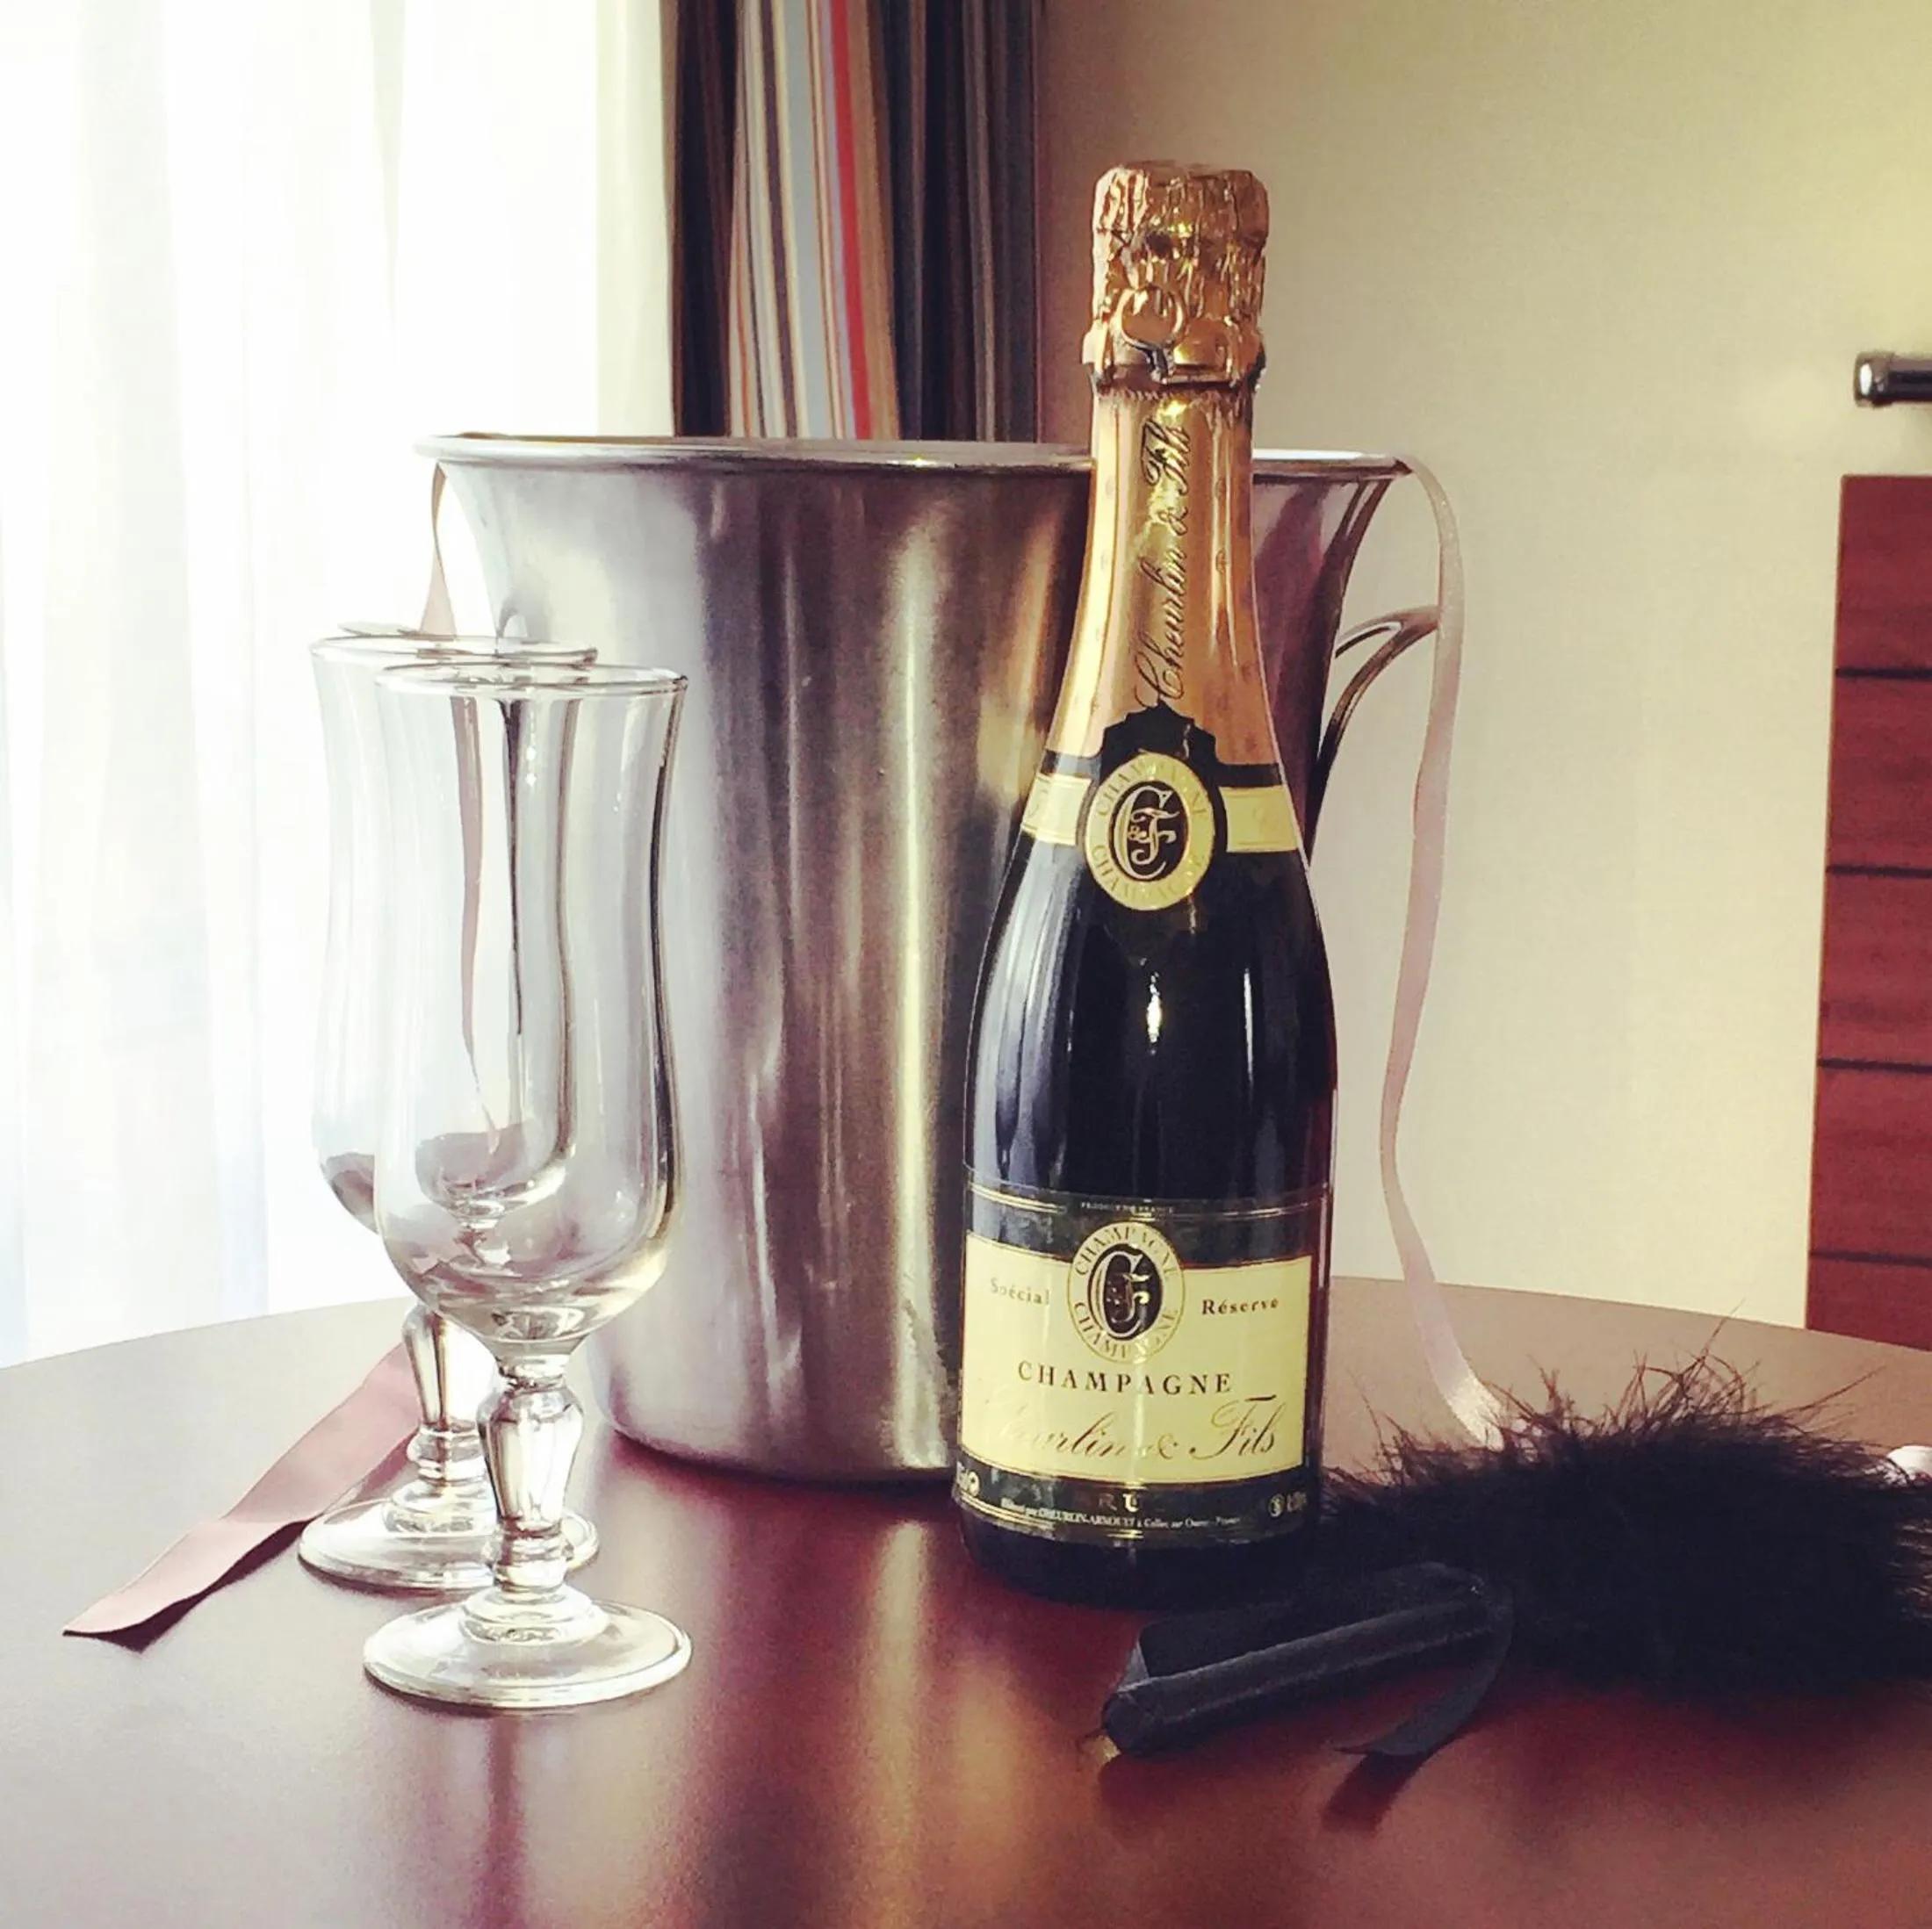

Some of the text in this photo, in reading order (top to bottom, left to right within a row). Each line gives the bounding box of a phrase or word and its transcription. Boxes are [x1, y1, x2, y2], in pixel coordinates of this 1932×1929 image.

[1201, 1297, 1279, 1315] Réserve
[1018, 1360, 1231, 1395] CHAMPAGNE
[1189, 1394, 1287, 1460] Fils
